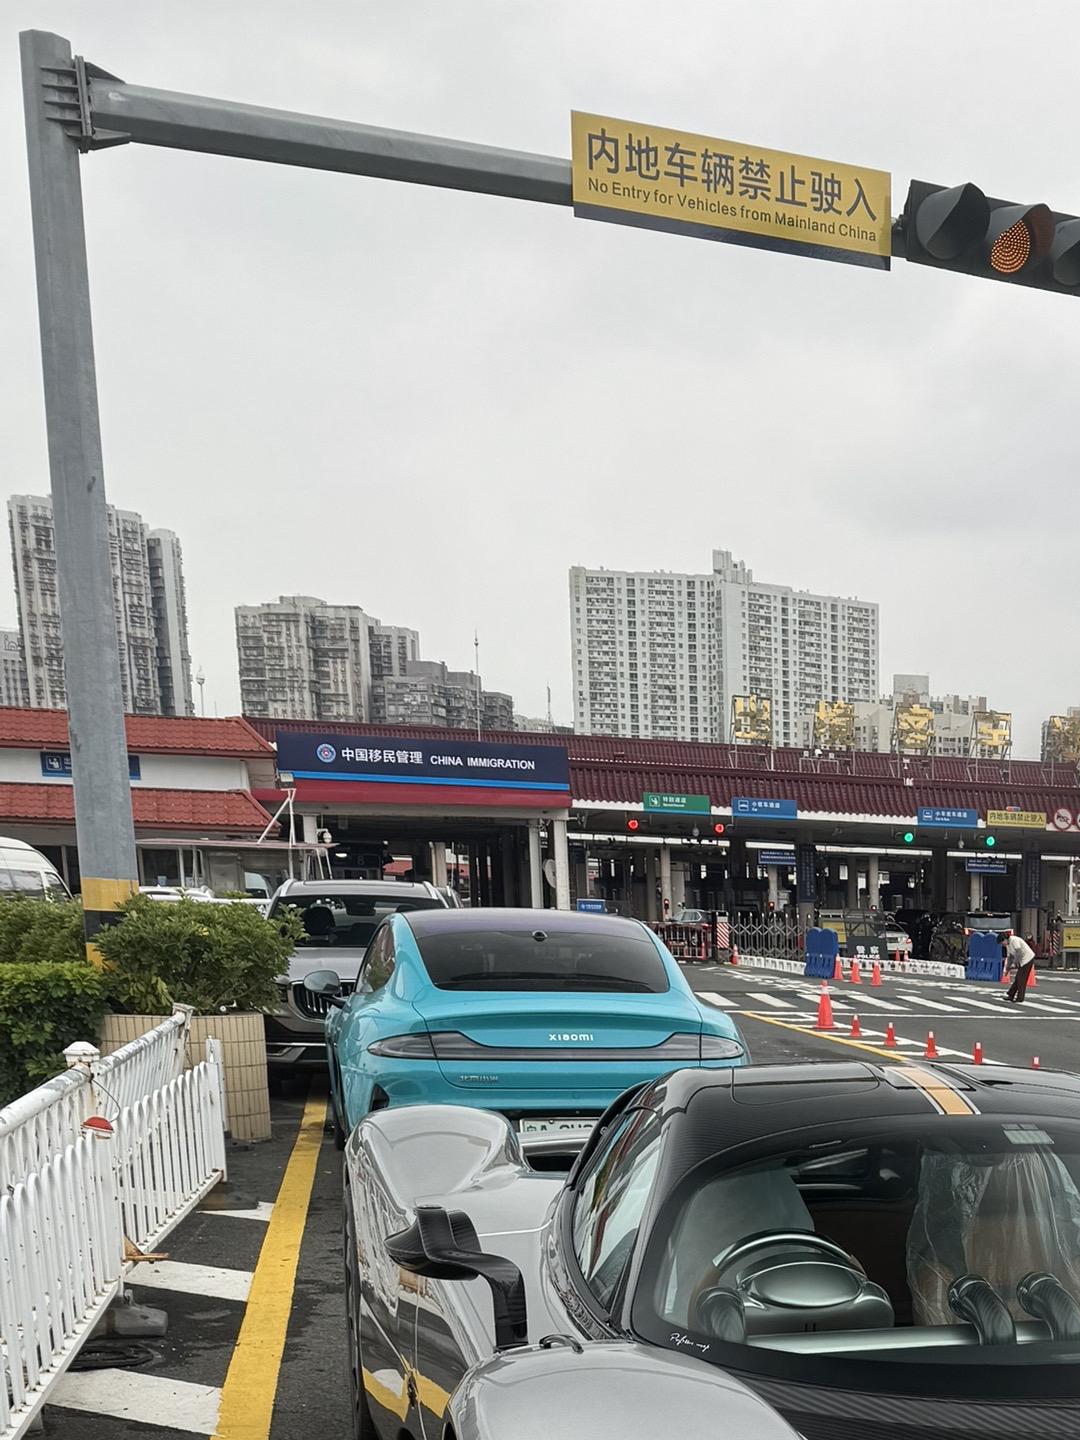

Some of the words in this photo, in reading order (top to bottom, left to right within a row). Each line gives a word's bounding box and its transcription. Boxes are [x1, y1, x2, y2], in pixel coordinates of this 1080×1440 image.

[587, 127, 877, 222] 内地车辆禁止驶入
[588, 177, 608, 194] No
[612, 181, 651, 203] Entry
[653, 189, 674, 206] for
[677, 193, 737, 217] Vehicles
[740, 205, 771, 223] from
[775, 211, 835, 235] Mainland
[838, 223, 877, 242] China
[341, 747, 423, 764] 中国移民管理
[430, 755, 463, 766] CHINA
[467, 757, 535, 770] IMMIGRATION
